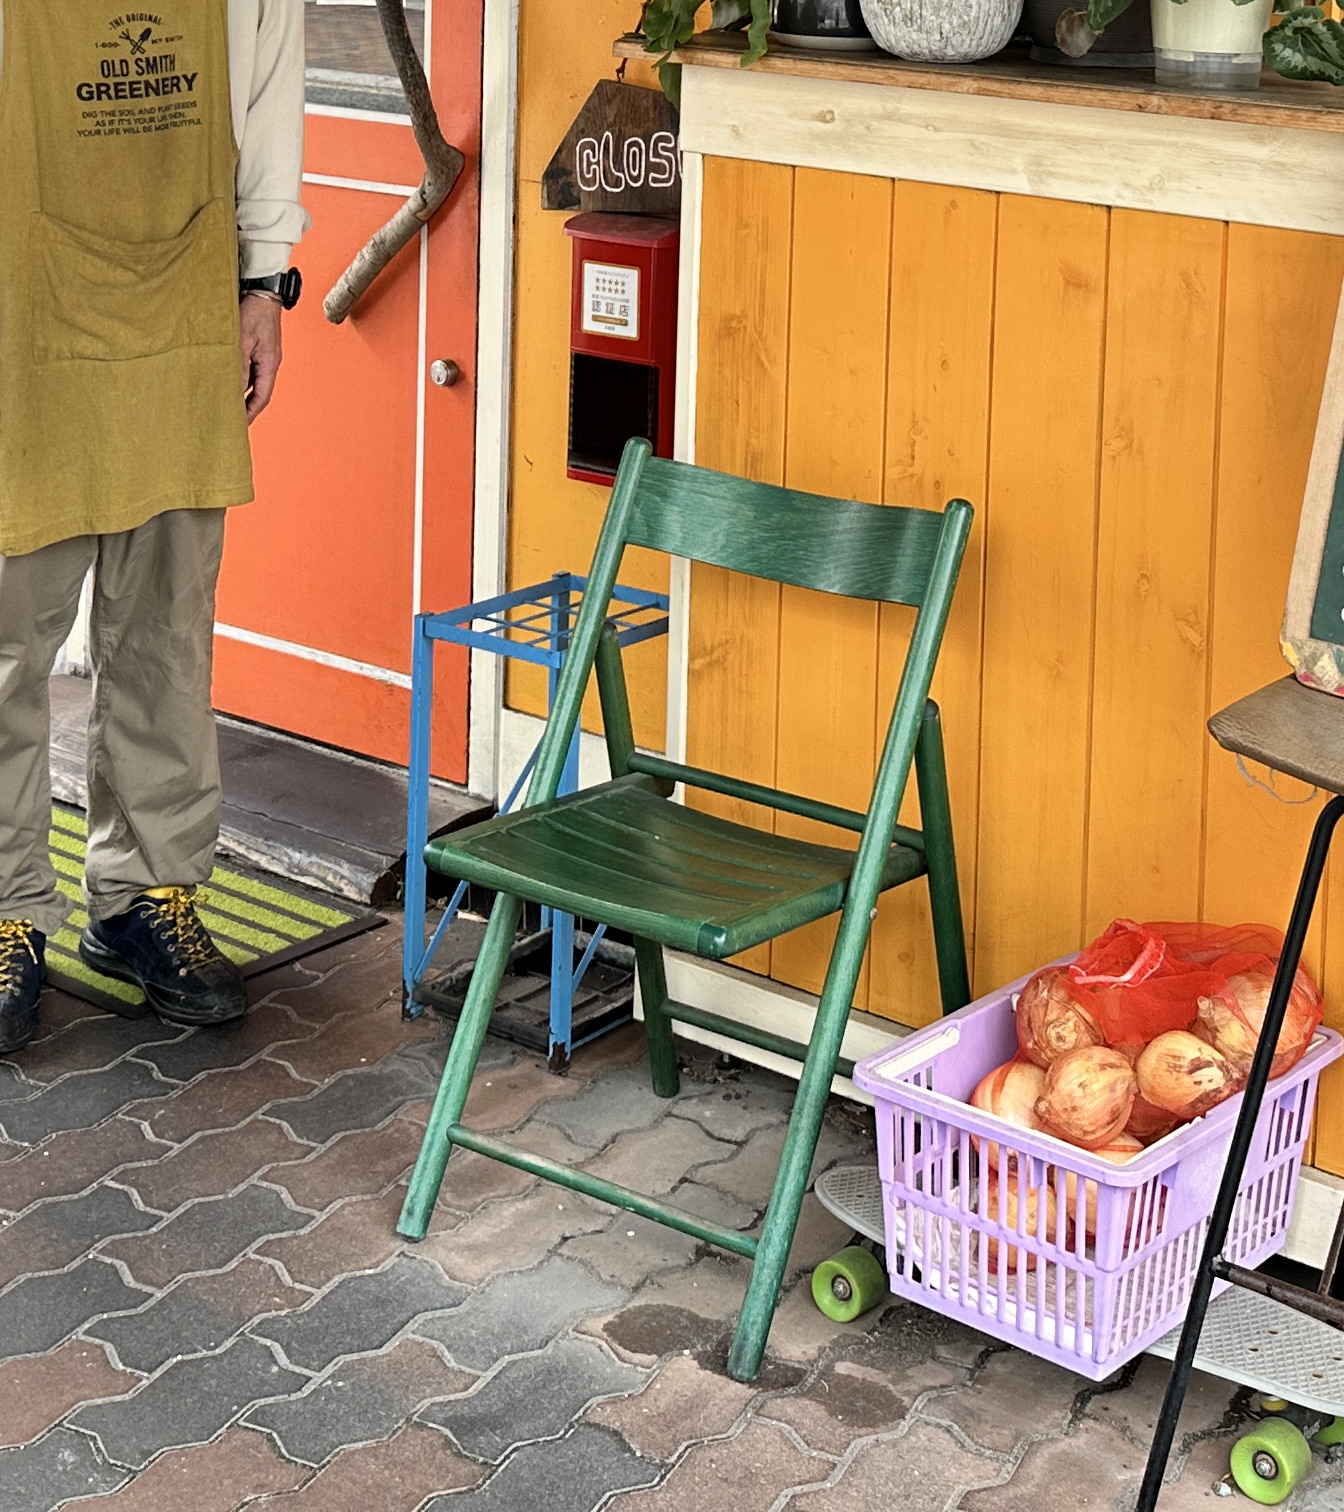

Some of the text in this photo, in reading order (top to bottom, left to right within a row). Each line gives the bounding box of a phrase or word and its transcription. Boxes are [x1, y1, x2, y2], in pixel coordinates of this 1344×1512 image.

[100, 52, 176, 79] OLD SMITH
[76, 72, 199, 102] GREENERY
[82, 110, 98, 119] DIG
[100, 109, 116, 118] THE
[138, 106, 156, 116] AND
[95, 119, 106, 128] AS
[108, 118, 116, 127] IF
[133, 115, 156, 125] YOUR
[77, 128, 101, 138] YOUR
[103, 127, 121, 136] LIFE
[122, 126, 142, 135] WILL
[142, 124, 153, 133] BE
[575, 130, 683, 194] CLOS
[592, 299, 629, 317] 認証店
